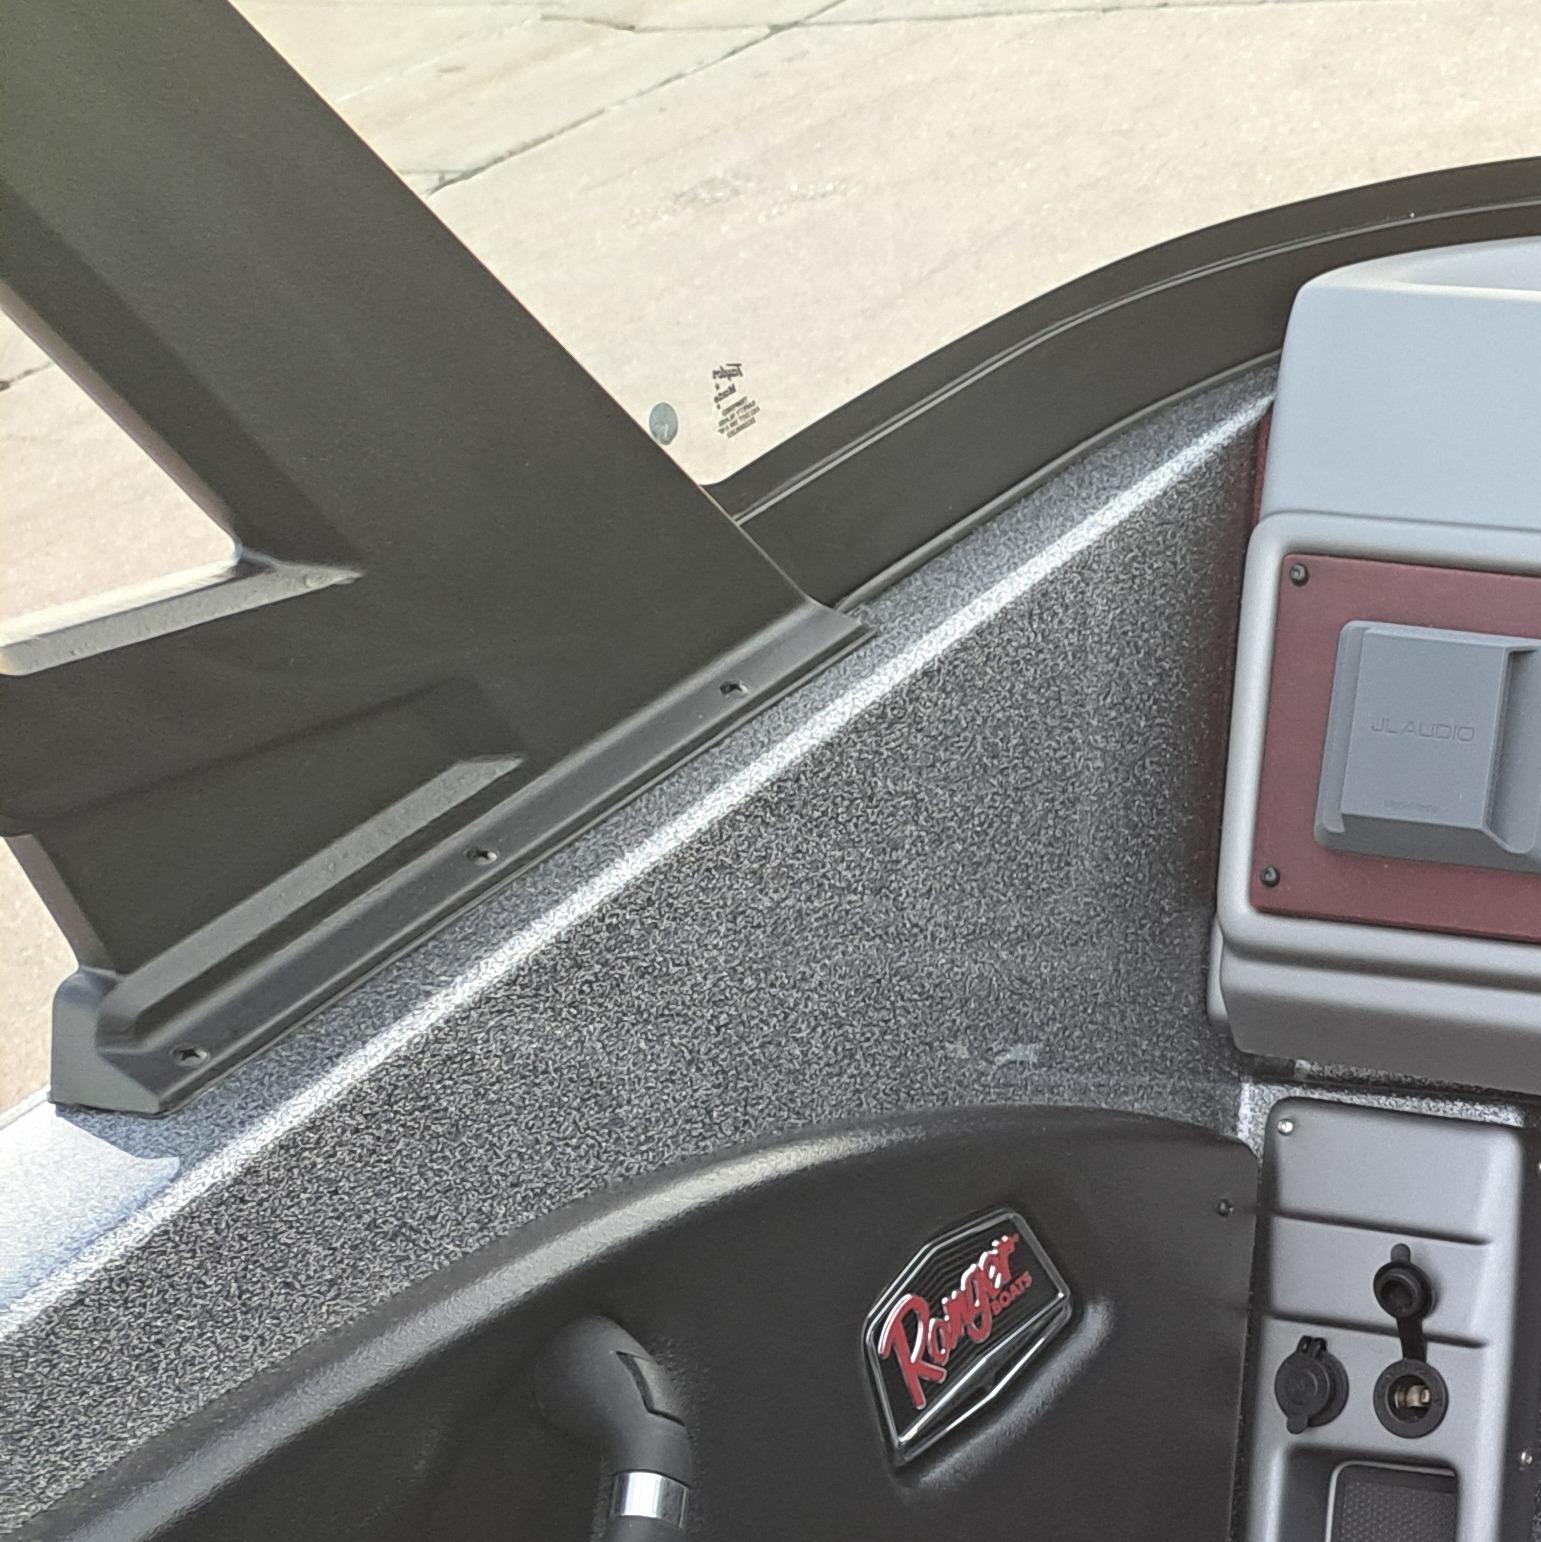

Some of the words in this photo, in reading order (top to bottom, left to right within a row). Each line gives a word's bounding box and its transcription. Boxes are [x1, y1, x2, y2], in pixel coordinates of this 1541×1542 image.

[1400, 720, 1476, 742] AUDIO
[991, 1271, 1033, 1316] BOATS
[877, 1234, 1016, 1410] Ranger
